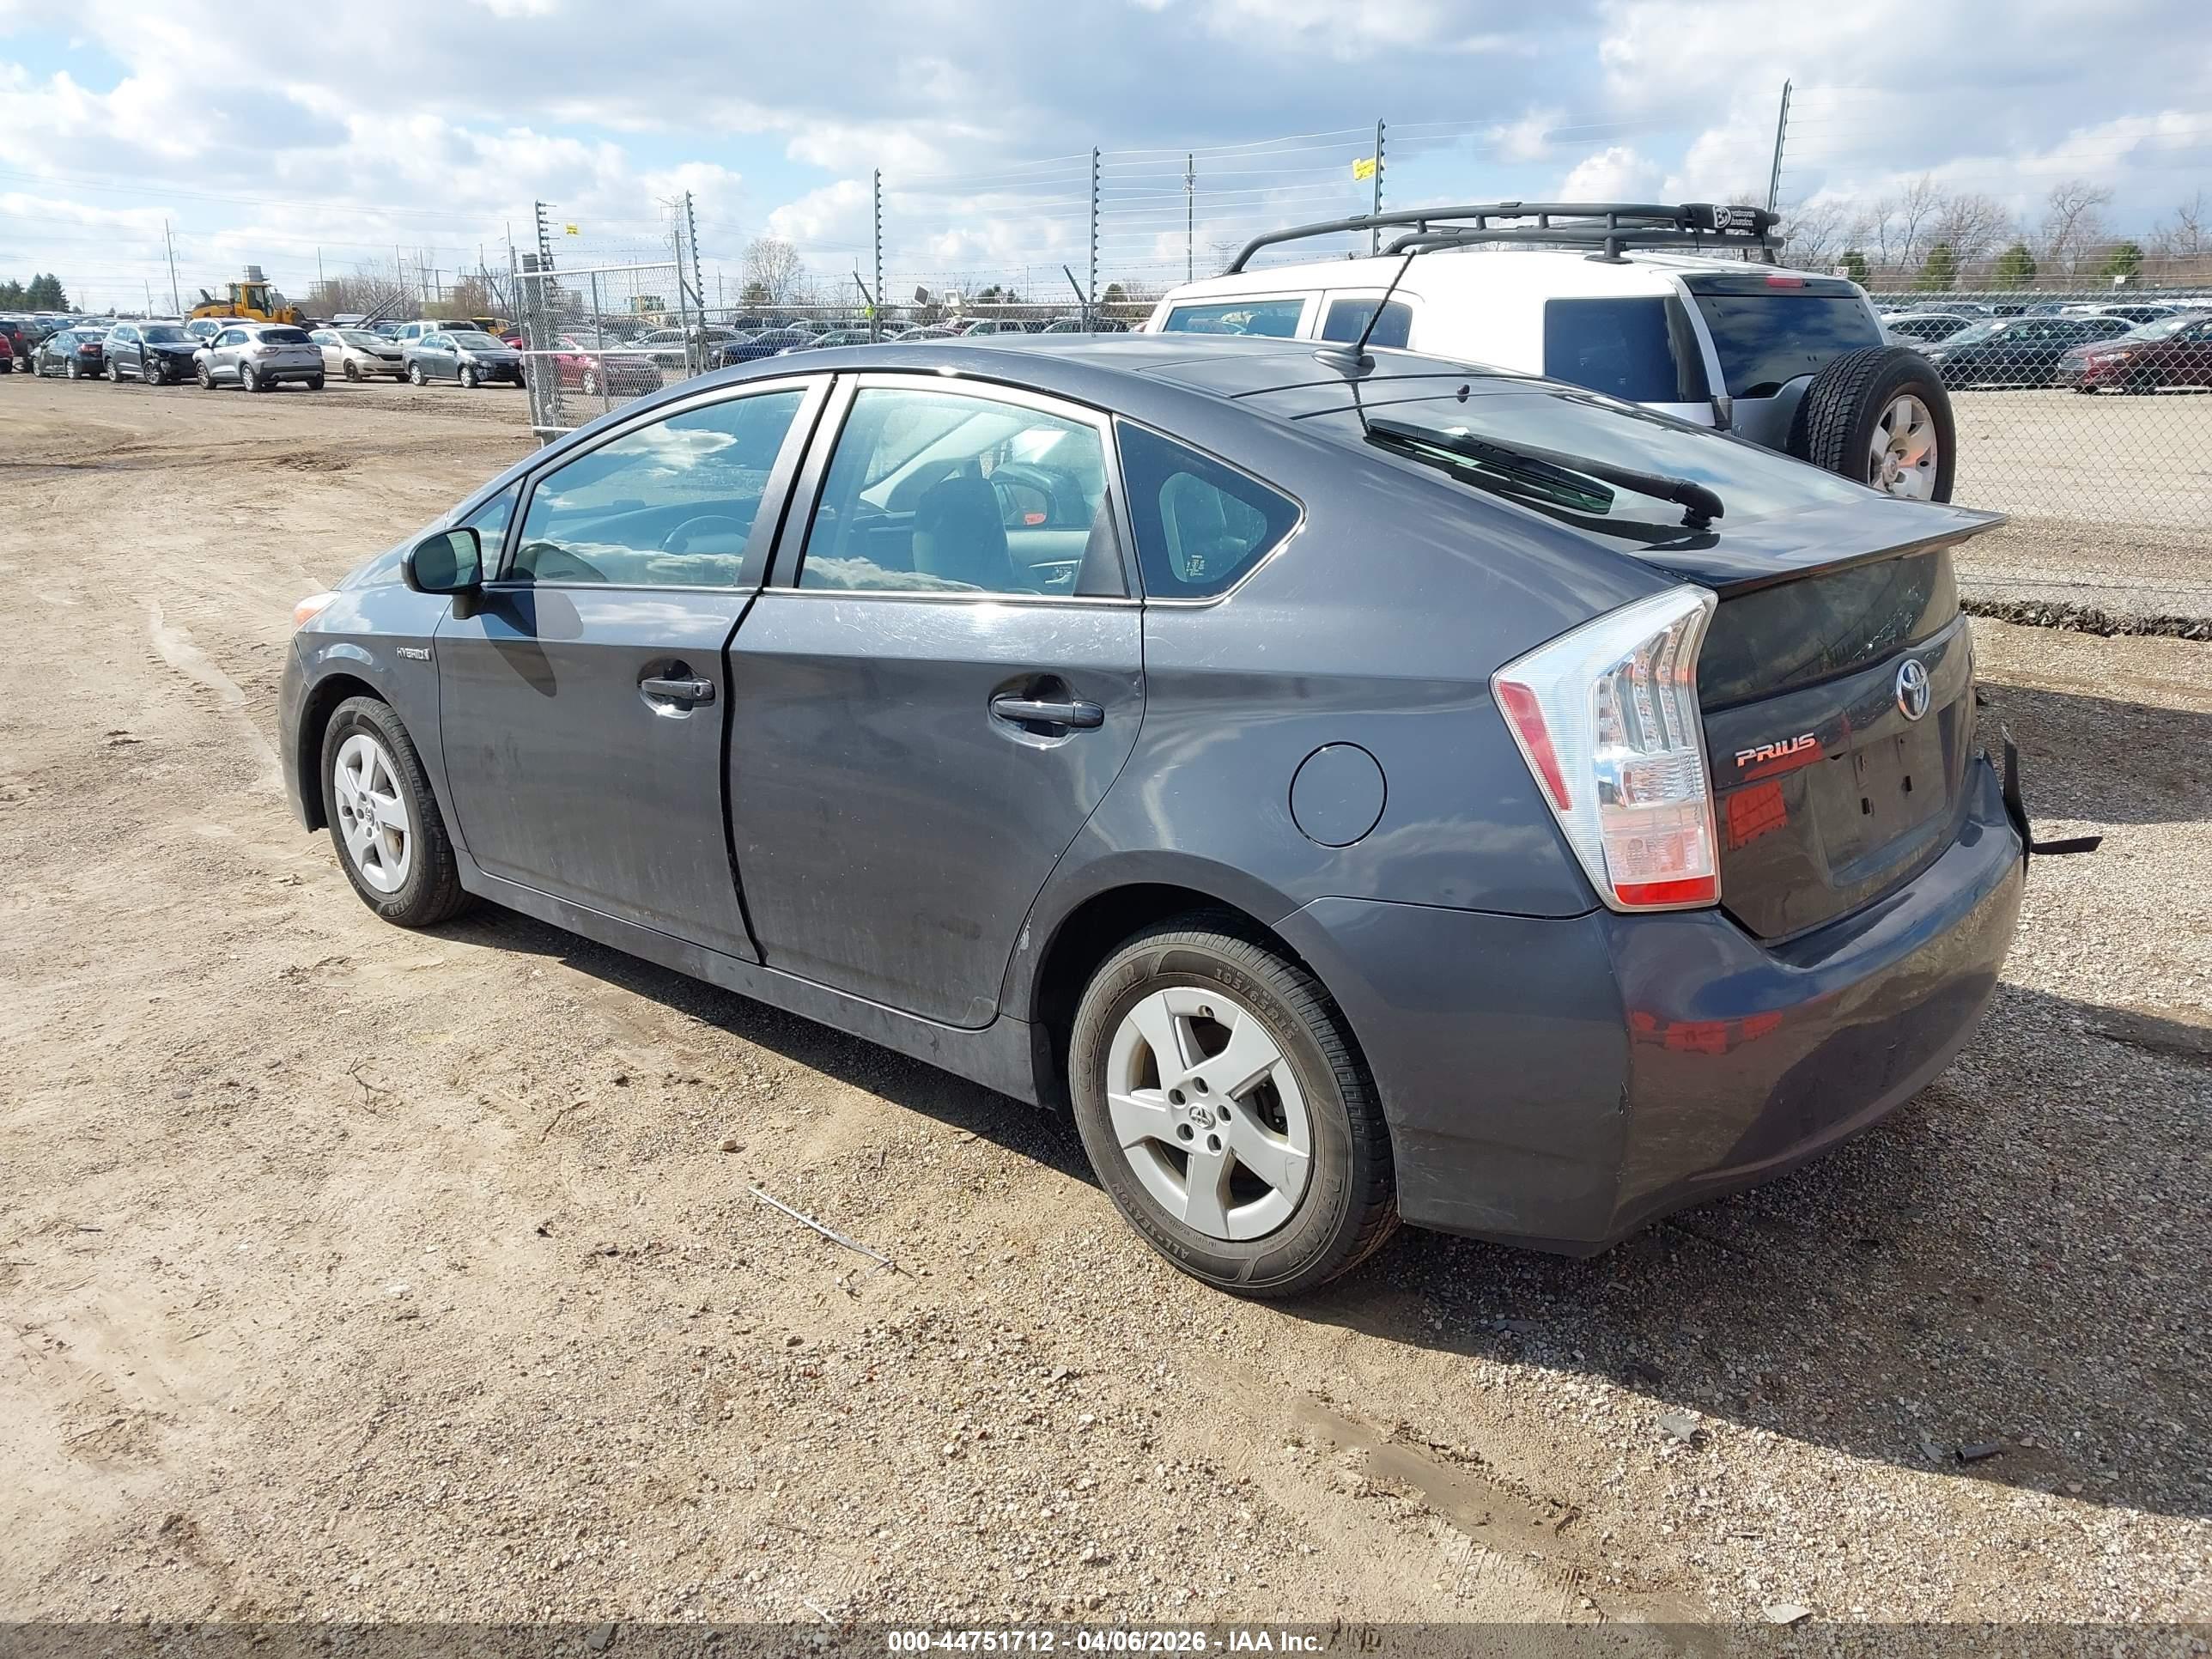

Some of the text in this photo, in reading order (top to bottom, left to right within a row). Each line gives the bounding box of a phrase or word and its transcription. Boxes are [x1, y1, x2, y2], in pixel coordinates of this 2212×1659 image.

[396, 647, 423, 659] HYBRID
[1735, 732, 1816, 768] PRIUS
[1113, 1183, 1189, 1260] ALL-SEASON
